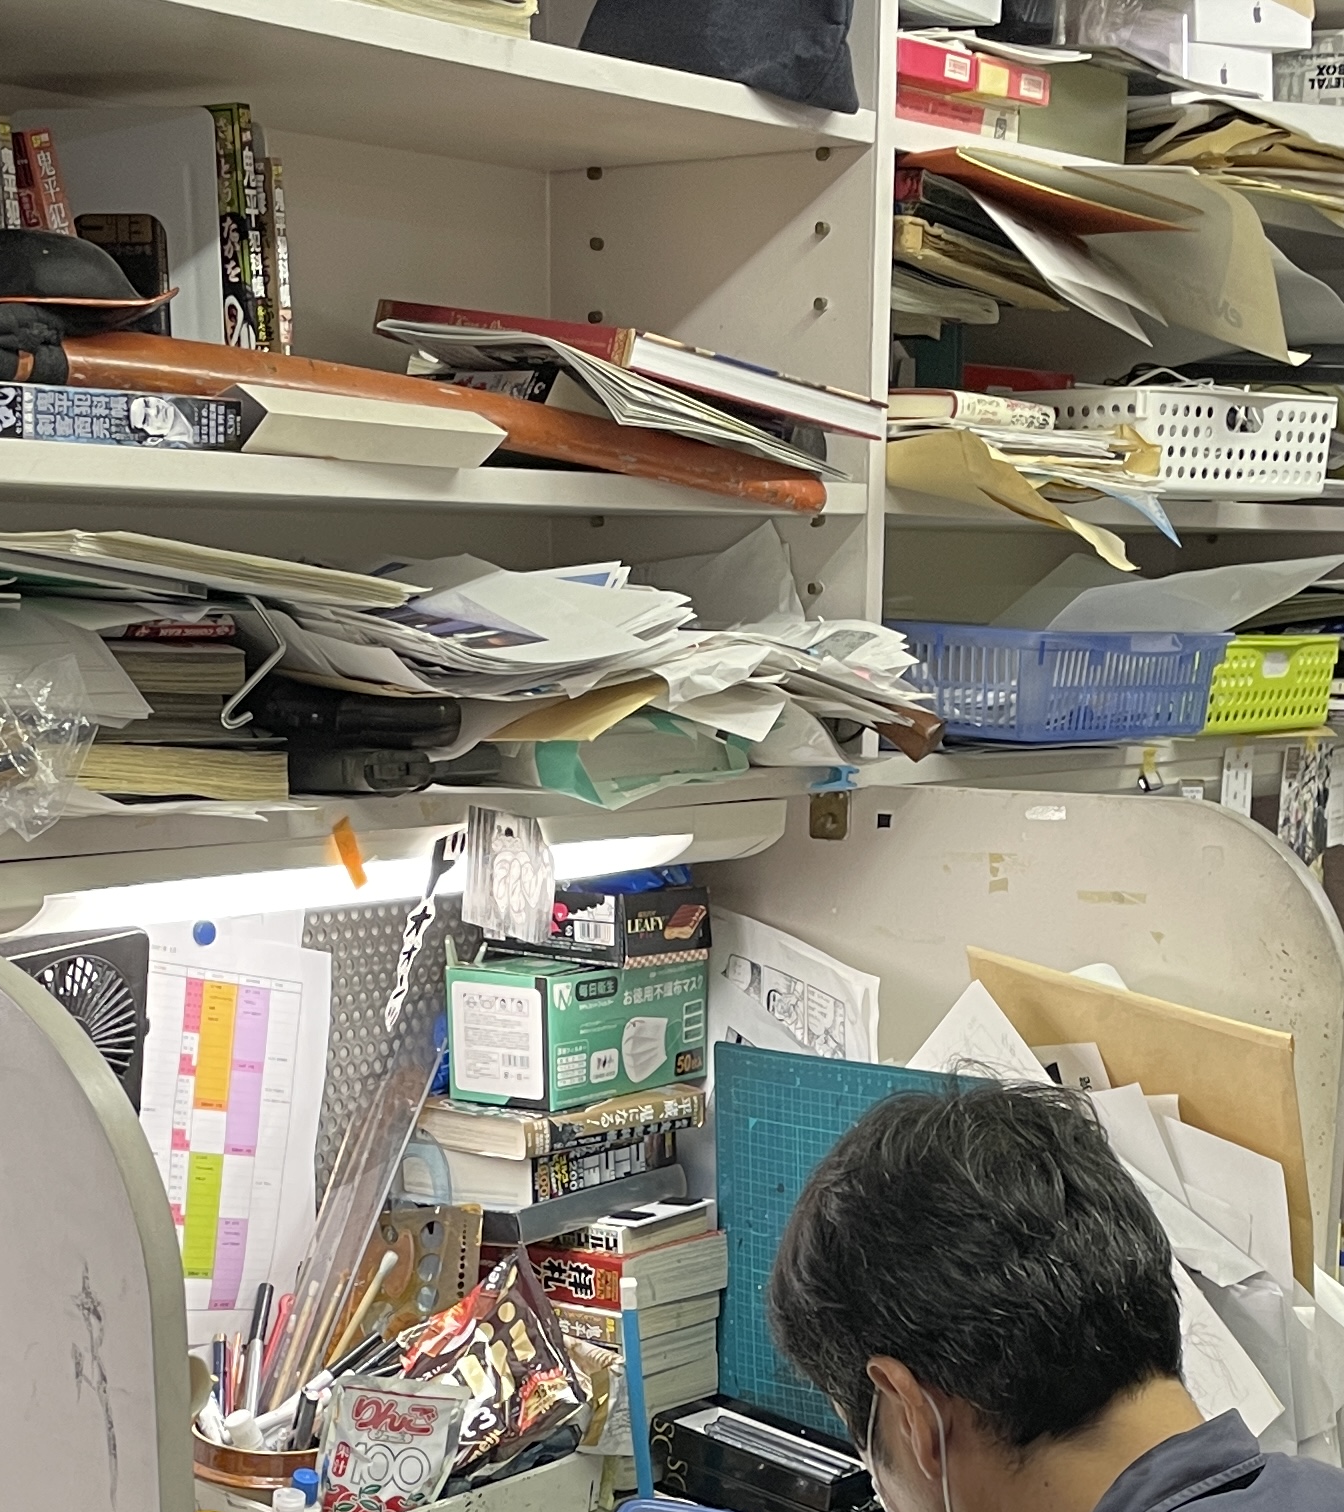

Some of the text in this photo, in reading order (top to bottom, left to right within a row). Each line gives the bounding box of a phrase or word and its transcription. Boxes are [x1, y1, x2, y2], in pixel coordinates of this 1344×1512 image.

[36, 391, 129, 417] 鬼平犯科帳
[627, 915, 665, 934] LEAFY
[352, 1395, 439, 1436] りんご
[351, 1441, 432, 1493] 100
